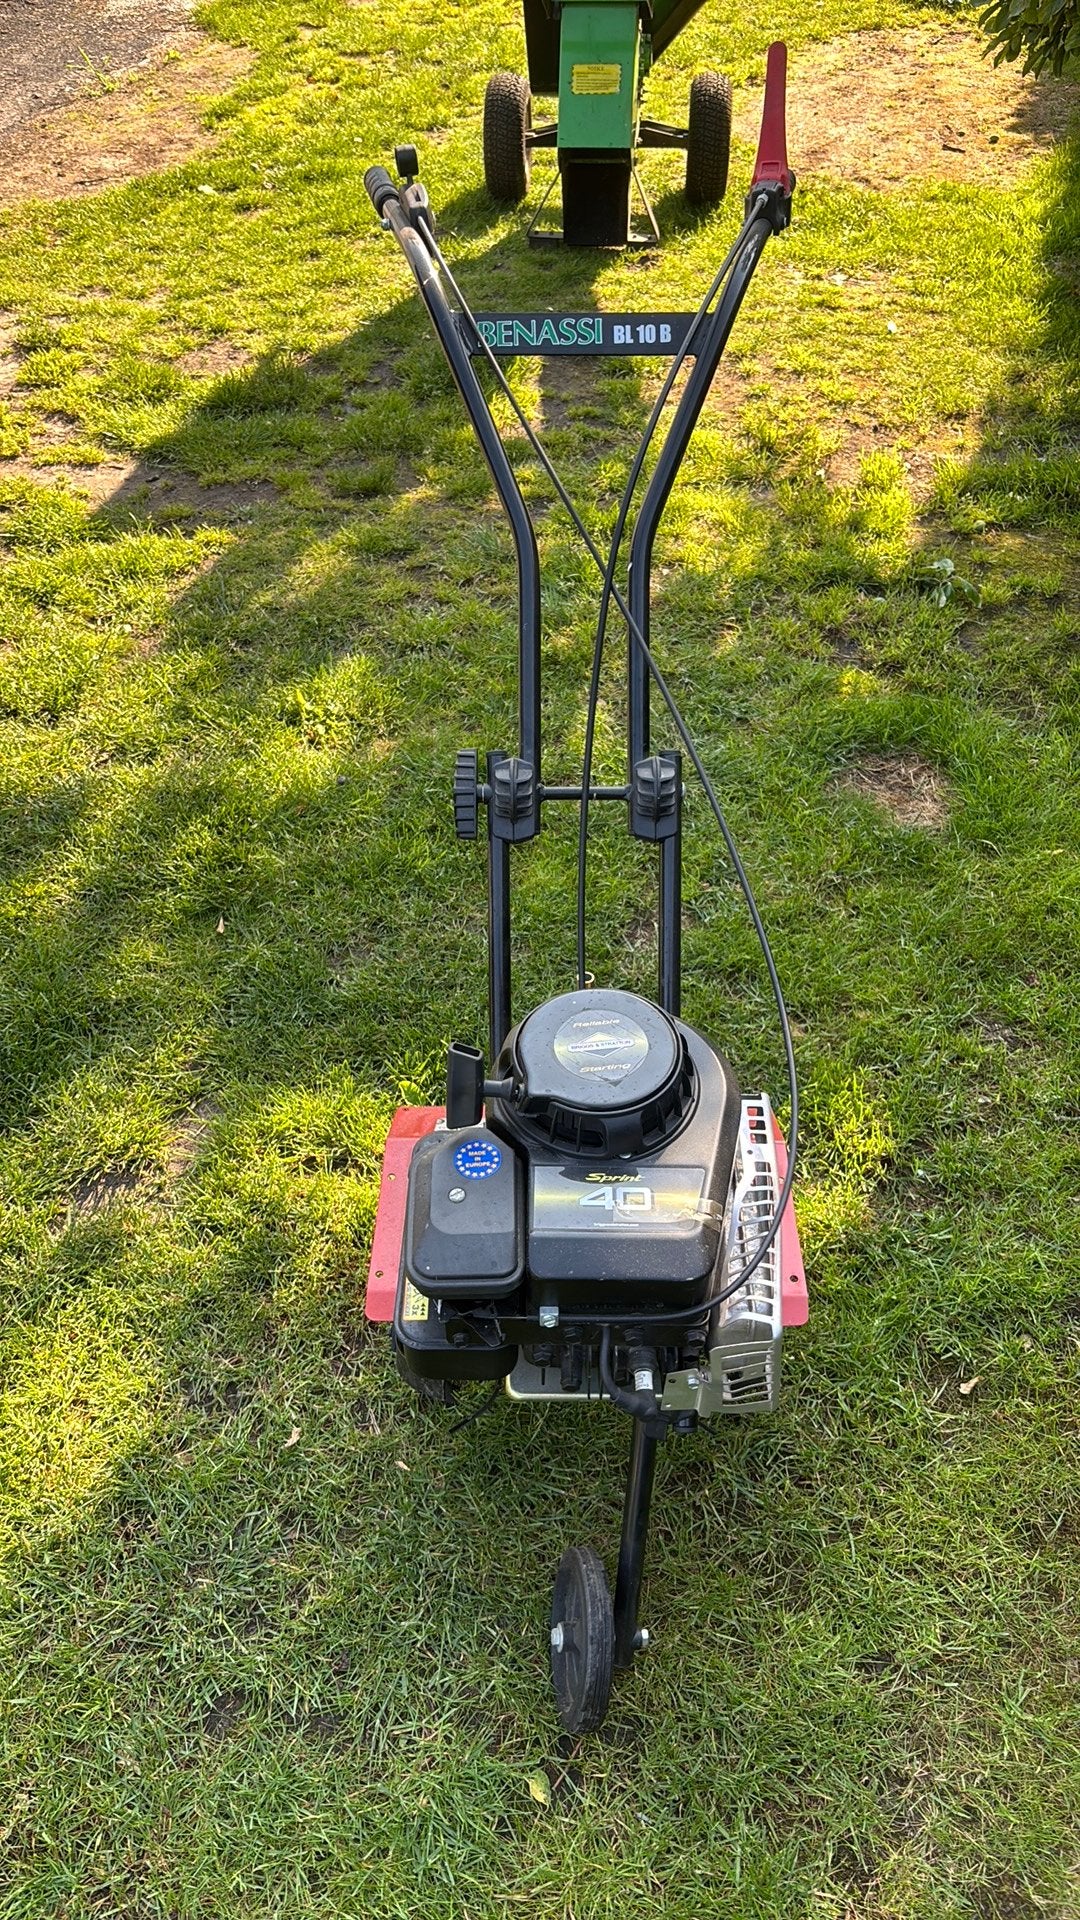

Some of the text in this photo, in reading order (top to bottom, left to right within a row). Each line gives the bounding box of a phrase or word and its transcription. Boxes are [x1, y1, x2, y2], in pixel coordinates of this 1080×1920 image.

[477, 318, 672, 347] BENASSI BL 10 B
[573, 1019, 620, 1028] Reliable
[580, 1063, 632, 1073] Starting
[585, 1172, 645, 1183] Sprint
[579, 1186, 652, 1211] 40
